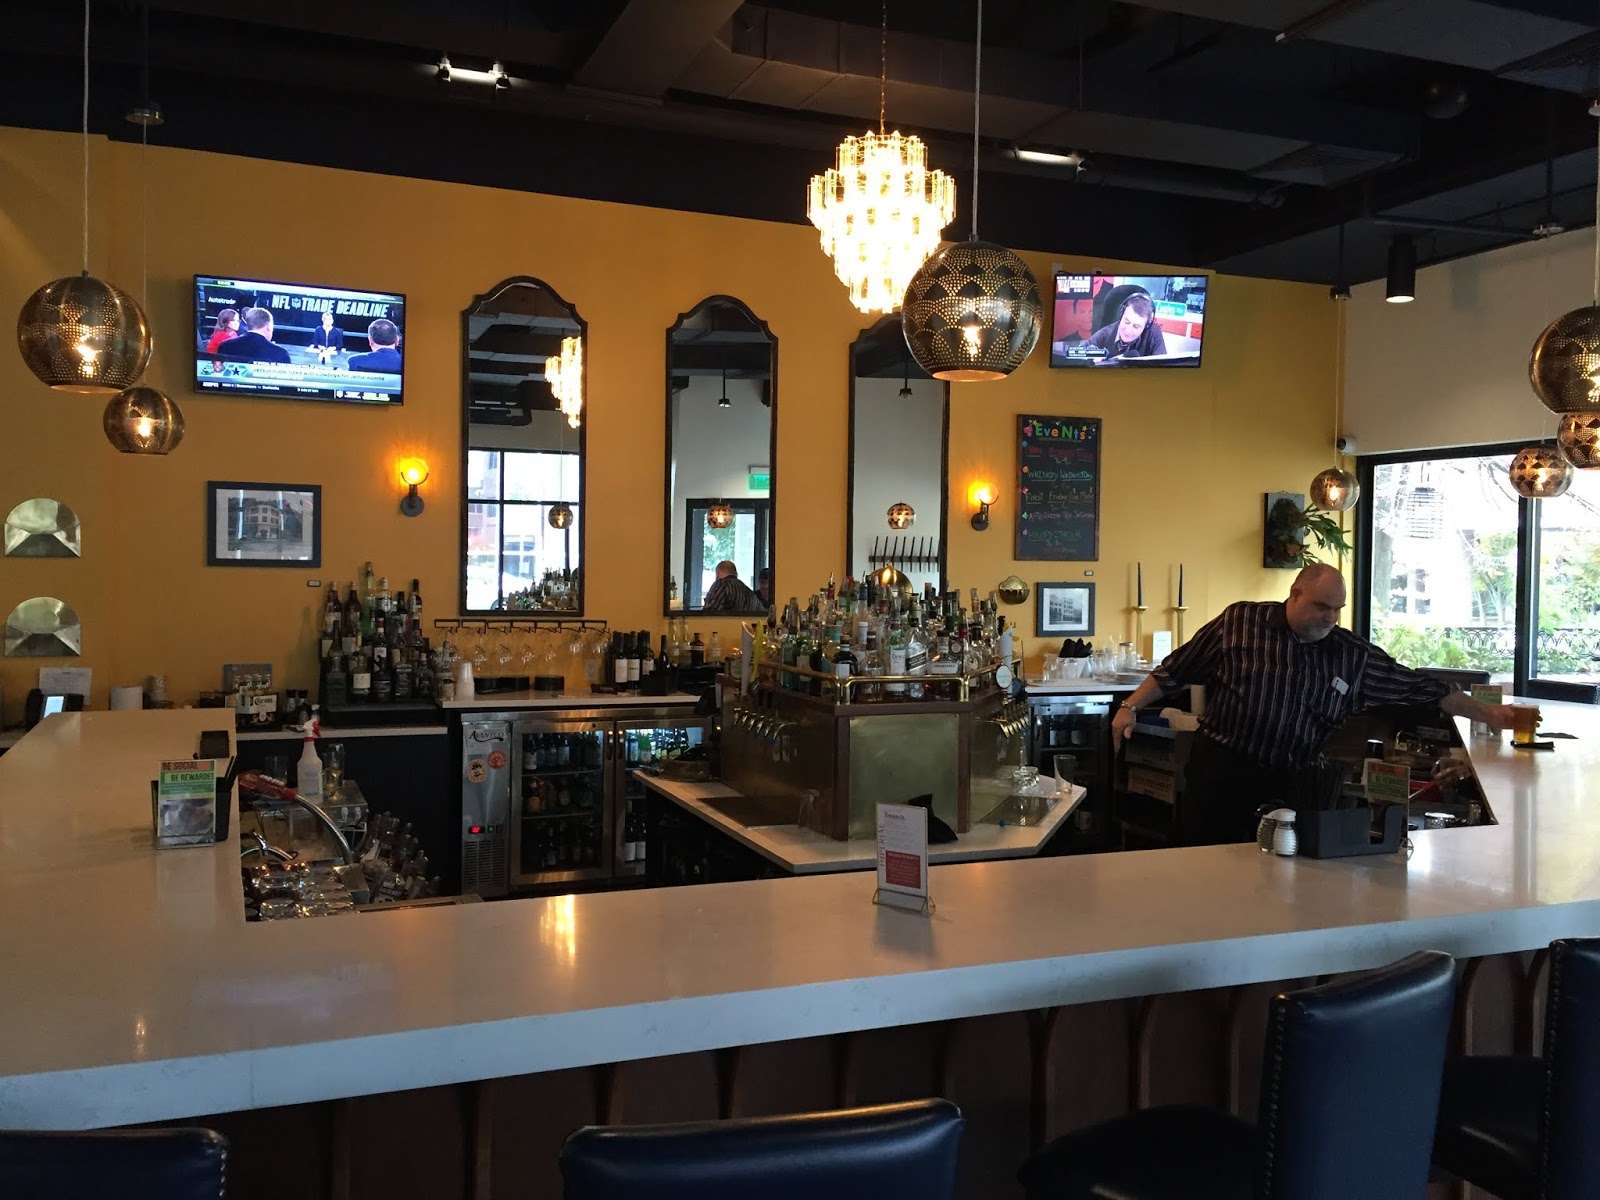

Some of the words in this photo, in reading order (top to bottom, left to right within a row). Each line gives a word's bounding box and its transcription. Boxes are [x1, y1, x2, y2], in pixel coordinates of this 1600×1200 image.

[271, 294, 291, 310] NFL
[301, 297, 335, 314] TRADE
[336, 300, 390, 318] DEADLINE
[162, 762, 172, 771] BE
[173, 761, 198, 770] SOCIAL
[171, 774, 179, 782] BE
